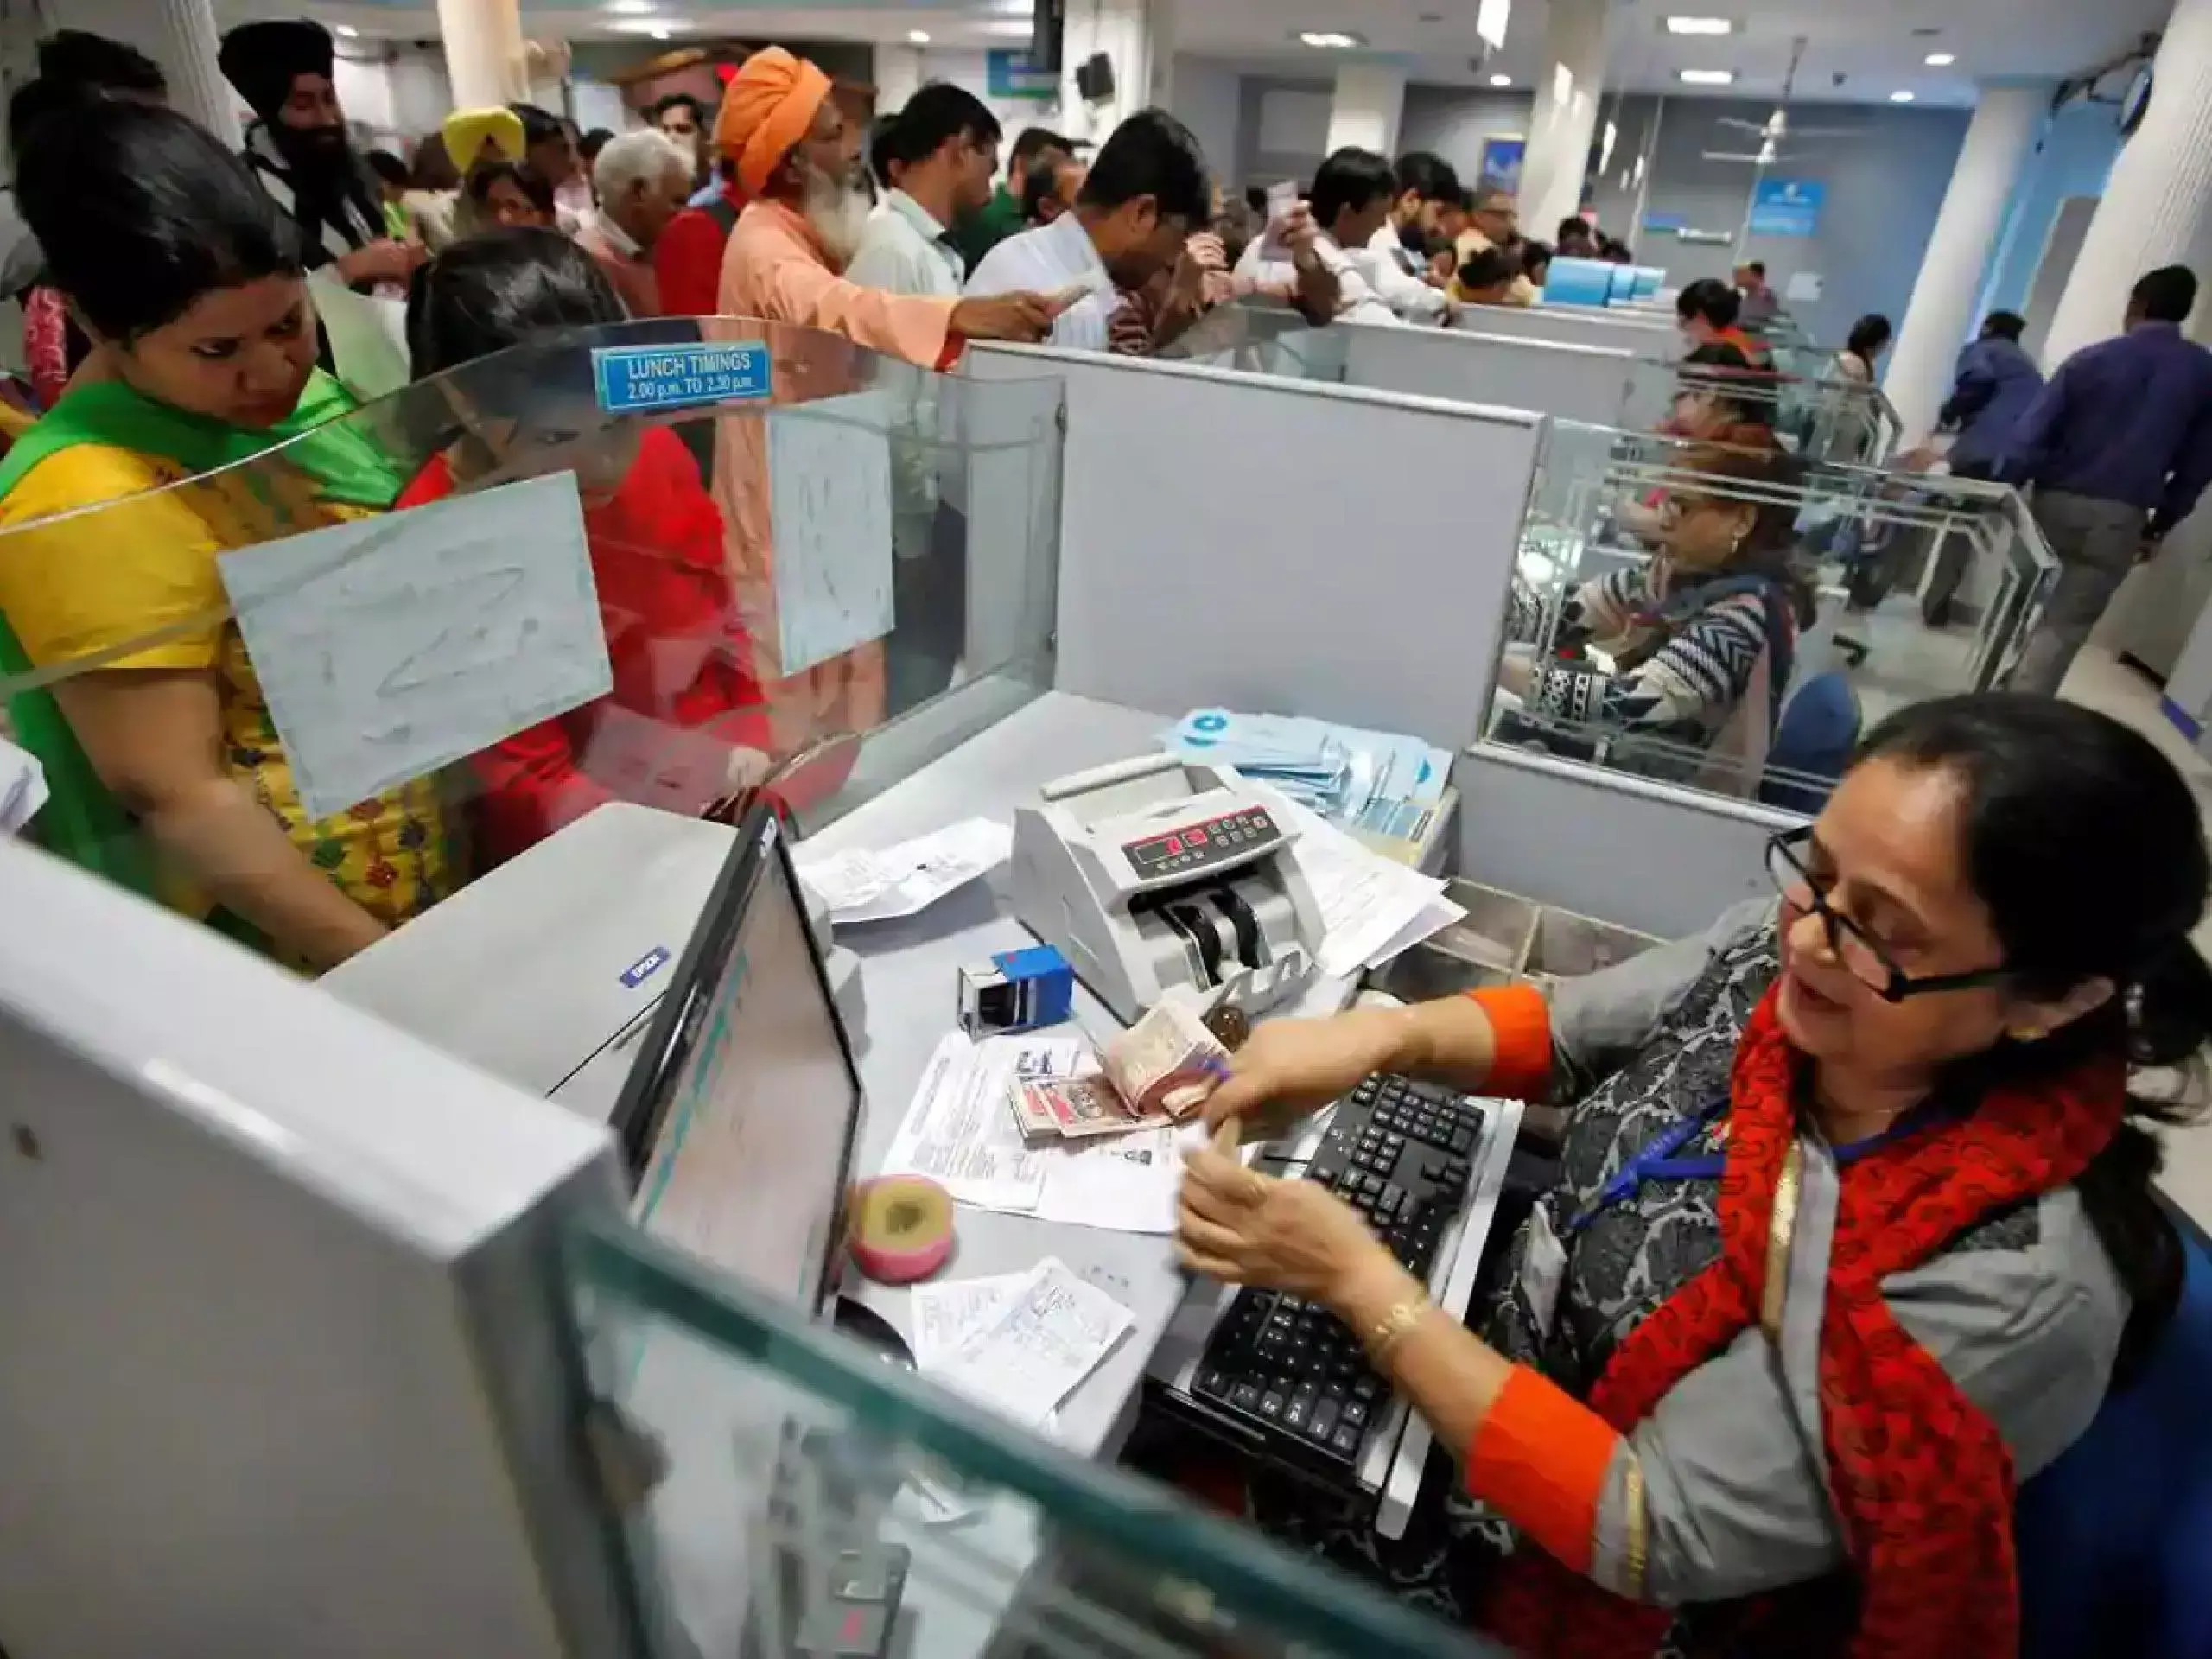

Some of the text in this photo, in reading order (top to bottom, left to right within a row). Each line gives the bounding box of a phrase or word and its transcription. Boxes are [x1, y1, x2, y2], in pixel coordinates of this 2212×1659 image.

[627, 351, 752, 378] LUNCH TIMINGS
[683, 378, 702, 393] TO
